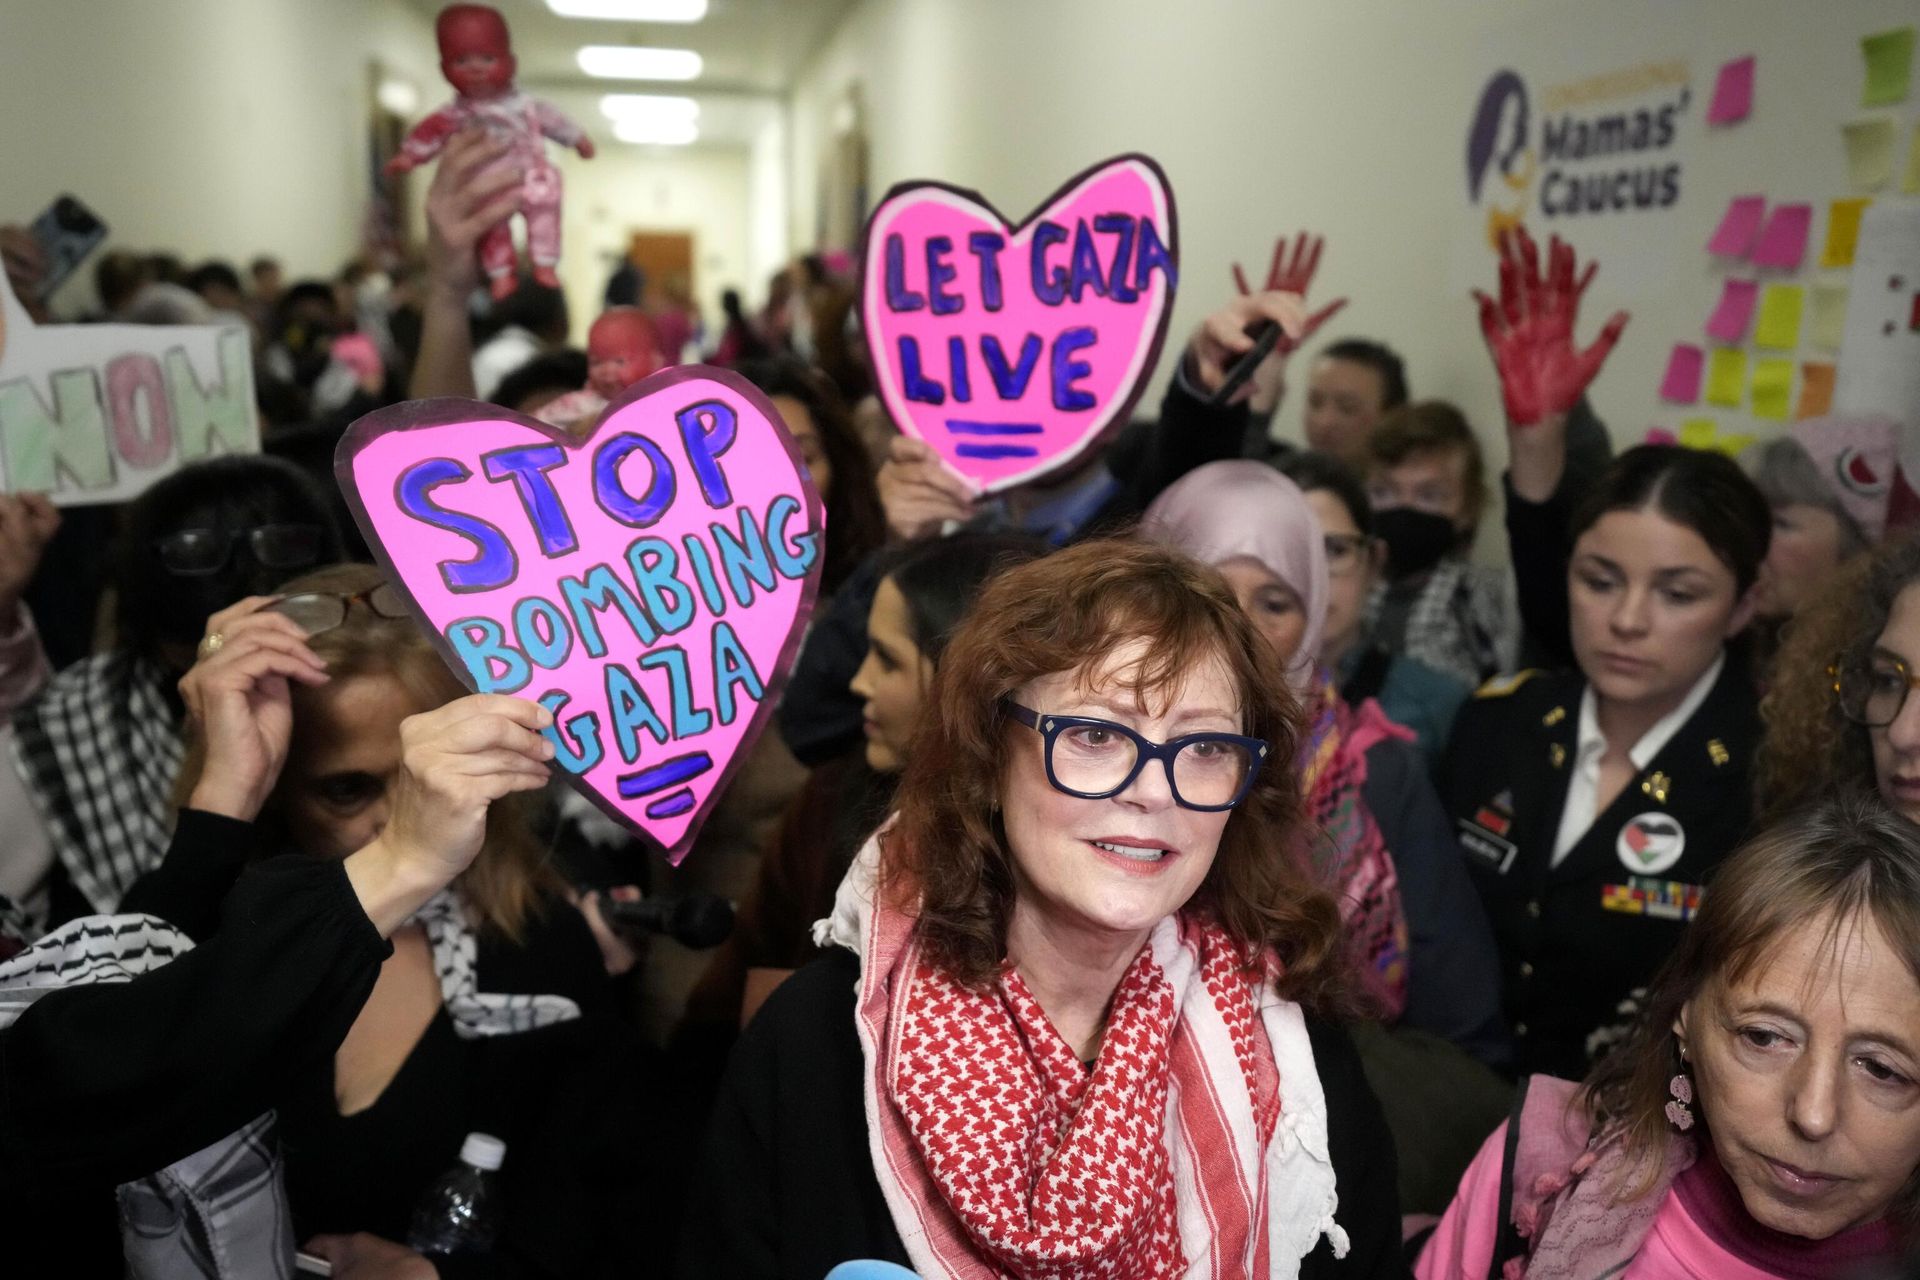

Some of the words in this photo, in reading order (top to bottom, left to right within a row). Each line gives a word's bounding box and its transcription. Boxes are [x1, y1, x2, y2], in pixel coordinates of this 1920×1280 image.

[884, 231, 1005, 316] LET
[1030, 211, 1179, 307] GAZA
[1541, 161, 1681, 217] Caucus
[0, 327, 250, 493] NOW
[896, 325, 1099, 412] LIVE
[394, 399, 738, 595] STOP
[443, 494, 819, 695] BOMBING
[535, 620, 766, 776] GAZA
